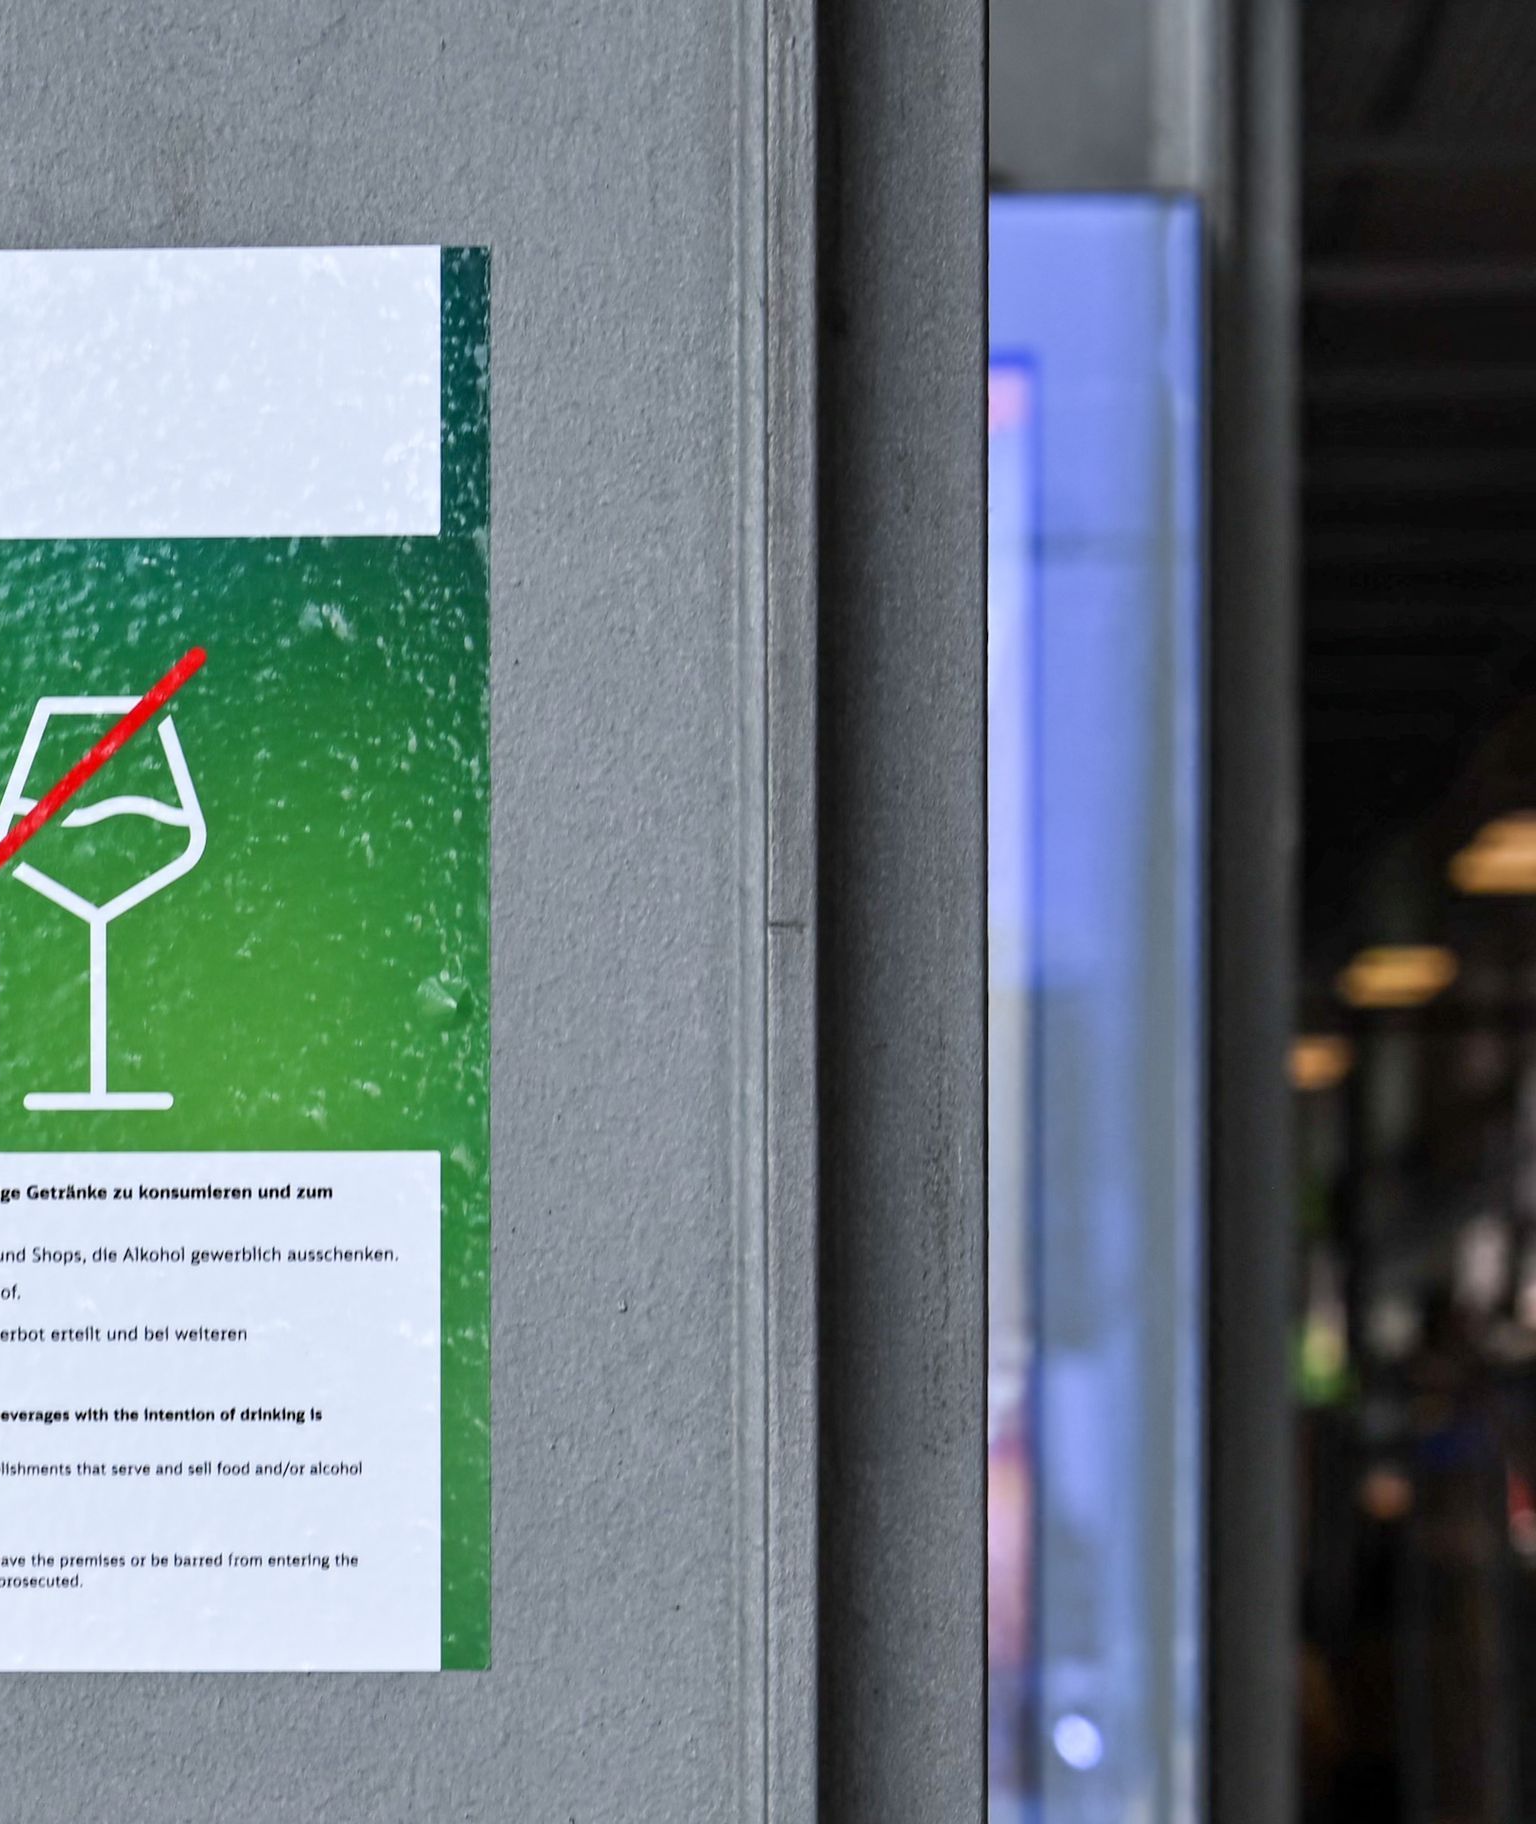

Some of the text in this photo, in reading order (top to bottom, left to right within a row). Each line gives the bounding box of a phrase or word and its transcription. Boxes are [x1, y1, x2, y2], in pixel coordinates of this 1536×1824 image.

[25, 1183, 108, 1201] Getränke
[112, 1187, 134, 1201] zu
[138, 1183, 253, 1201] konsumieren
[257, 1183, 292, 1200] und
[295, 1187, 334, 1200] zum
[31, 1246, 87, 1267] Shops,
[91, 1245, 118, 1263] die
[122, 1245, 186, 1263] Alkohol
[190, 1245, 282, 1266] gewerblich
[287, 1245, 399, 1263] ausschenken.
[50, 1324, 102, 1342] erteilt
[106, 1324, 139, 1342] und
[144, 1324, 169, 1342] bei
[174, 1325, 248, 1342] weiteren
[74, 1406, 109, 1422] with
[112, 1406, 140, 1422] the
[143, 1406, 216, 1422] intention
[219, 1406, 237, 1422] of
[239, 1406, 306, 1426] drinking
[309, 1406, 323, 1422] is
[76, 1460, 107, 1476] that
[111, 1464, 151, 1476] serve
[155, 1460, 183, 1476] and
[187, 1460, 212, 1476] sell
[216, 1460, 251, 1476] food
[254, 1460, 306, 1479] and/or
[309, 1460, 363, 1476] alcohol
[30, 1552, 55, 1568] the
[59, 1552, 126, 1570] premises
[130, 1555, 147, 1568] or
[150, 1552, 169, 1568] be
[173, 1552, 223, 1568] barred
[227, 1552, 263, 1568] from
[267, 1553, 331, 1571] entering
[334, 1552, 359, 1568] the
